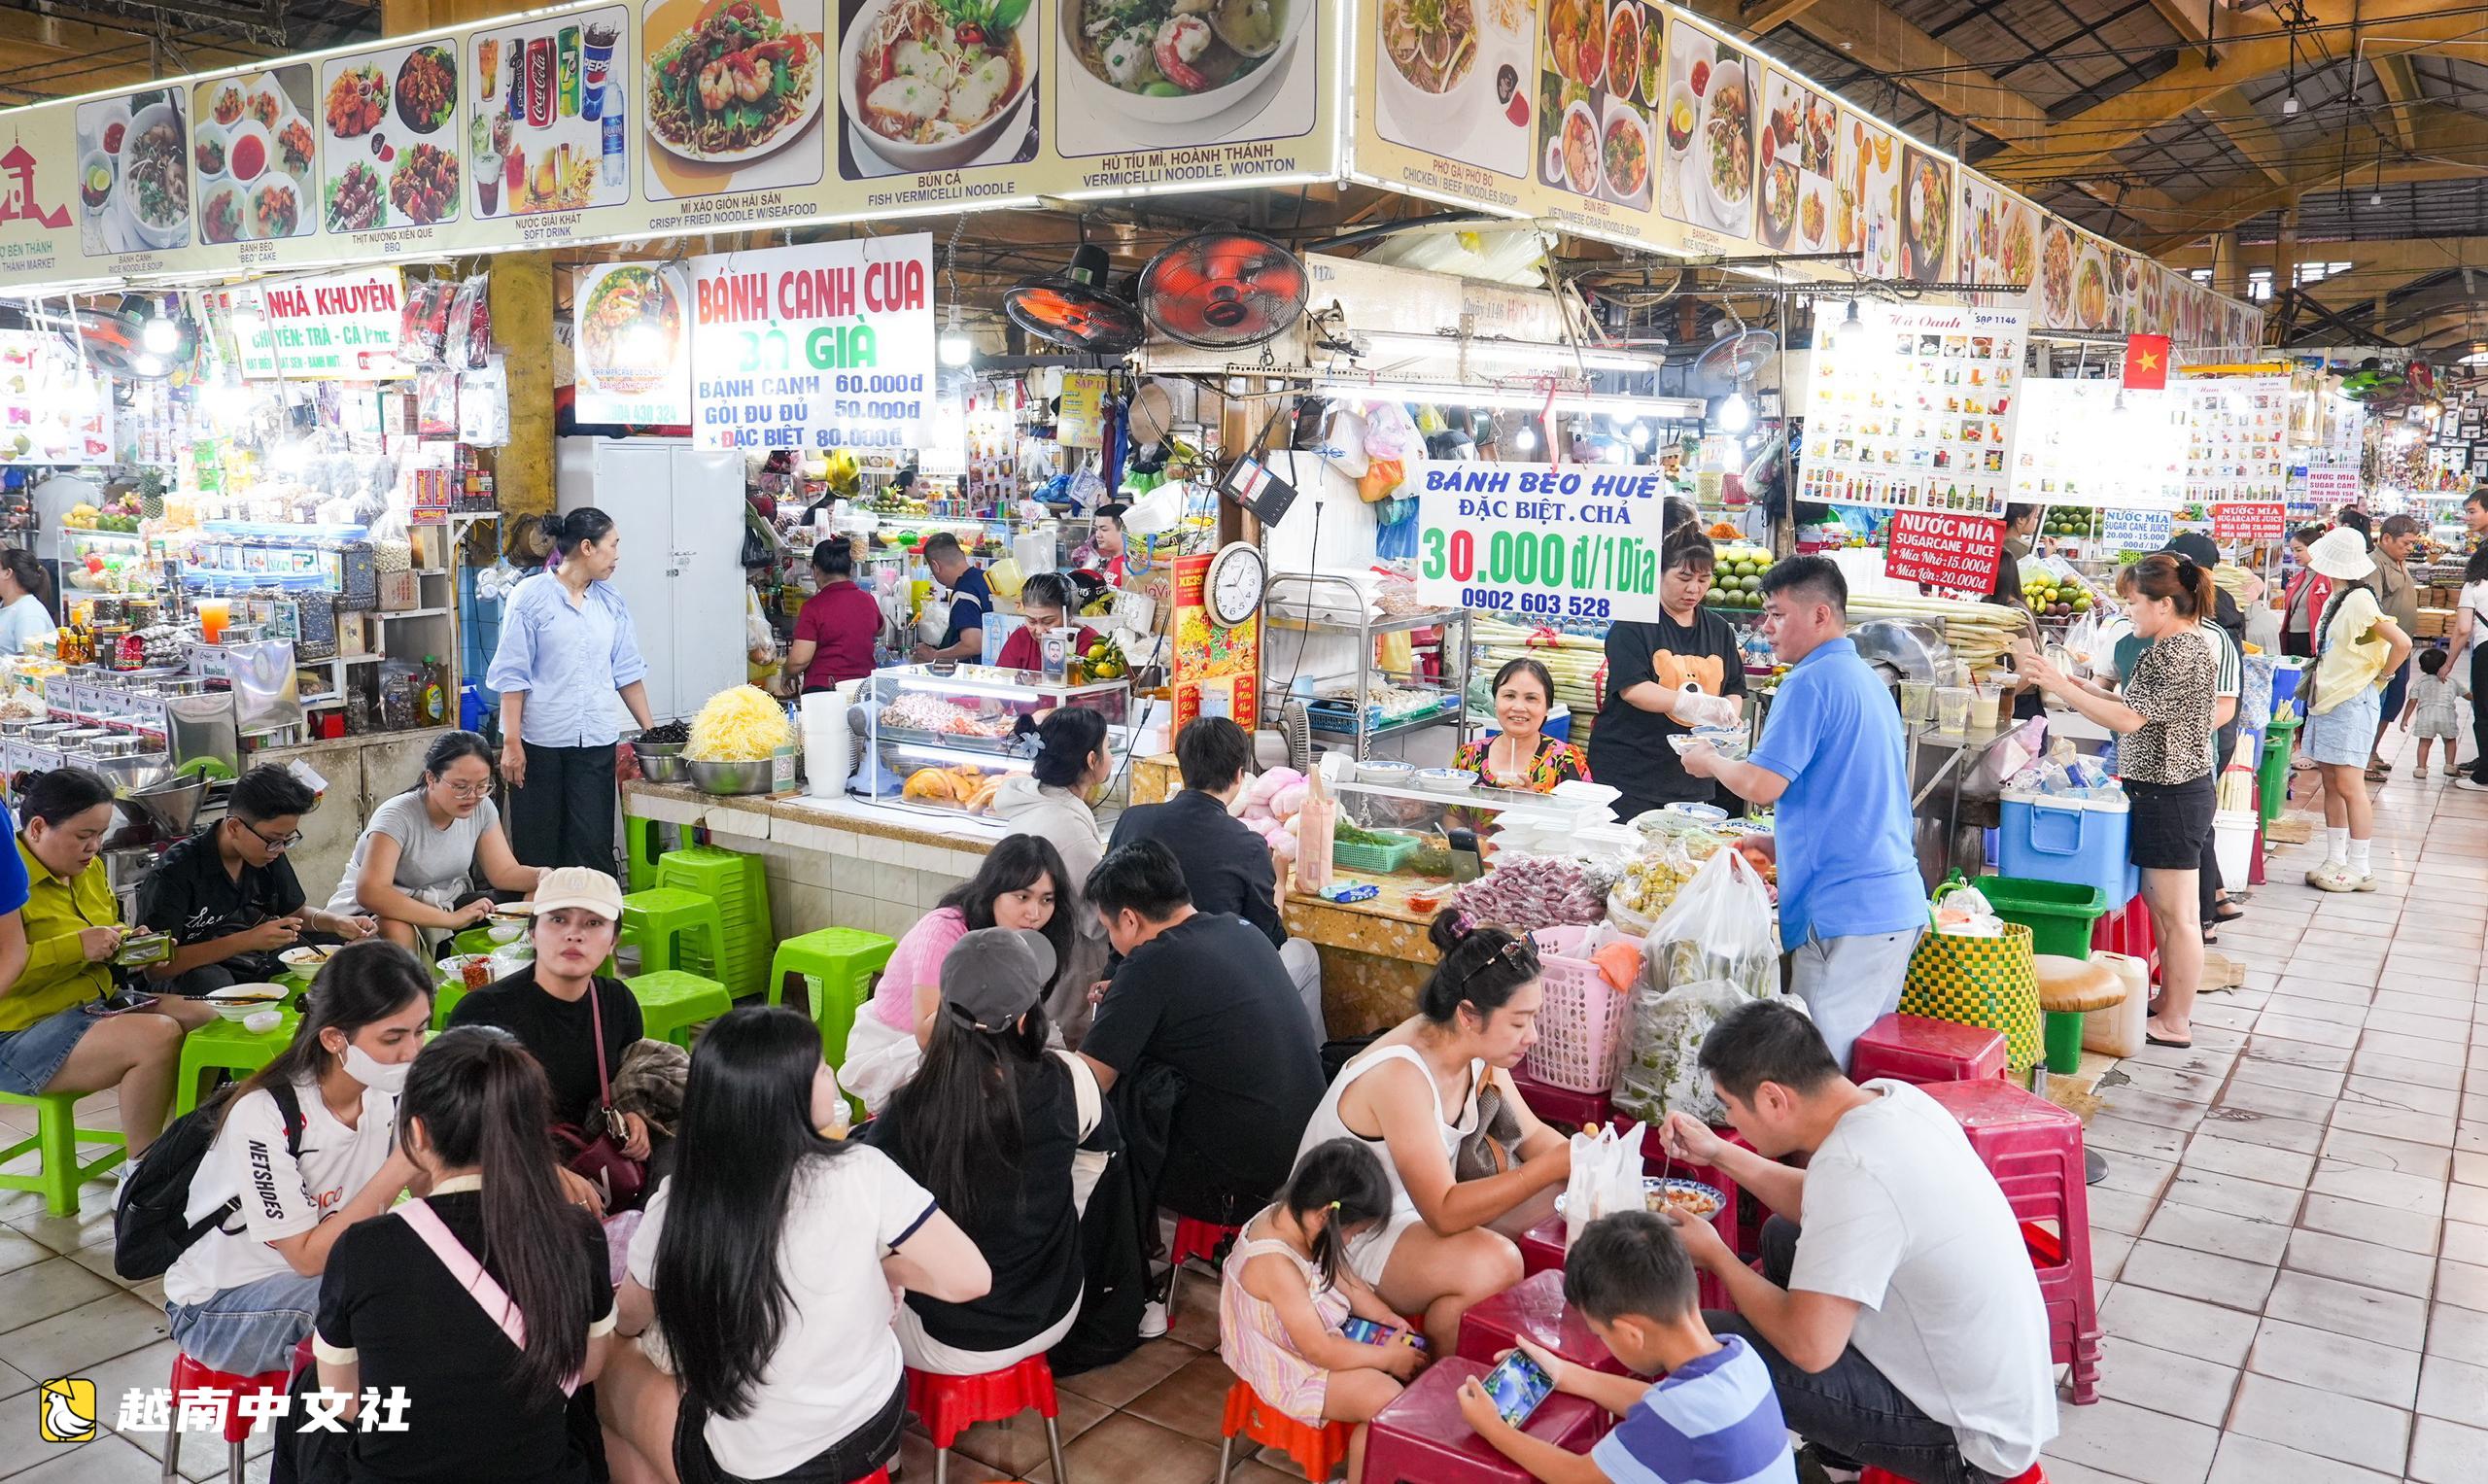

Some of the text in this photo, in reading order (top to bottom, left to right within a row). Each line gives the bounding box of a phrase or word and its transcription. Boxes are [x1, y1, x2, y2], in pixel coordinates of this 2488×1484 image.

[1102, 142, 1274, 171] HỦ TÍU MÌ, HOÀNH THÁNH
[917, 169, 962, 189] BÚN CÁ
[1084, 157, 1296, 188] VERMICELLI NOODLE, WONTON
[868, 182, 1015, 207] FISH VERMICELLI NOODLE
[1402, 166, 1518, 207] CHICKEN BEEF NOODLES SOUP
[649, 202, 817, 231] CRISPY FRIED NOODLE W/SEAFOOD
[1547, 205, 1641, 238] VIETNAMESE CRAB NOODLE SOUP
[416, 227, 433, 240] QUE
[524, 227, 571, 241] SOFT DRINK
[259, 251, 277, 262] CAKE
[384, 242, 400, 254] BBQ
[26, 257, 55, 270] MARKET
[108, 260, 163, 274] RICE NOODLE SOUP
[267, 277, 397, 319] NHÃ KHUYÊN
[698, 259, 924, 325] BÁNH CANH CUA
[1975, 315, 2017, 326] SẠP 1146
[805, 313, 878, 370] GIÀ
[699, 373, 923, 398] BÁNH CANH 60.000đ
[705, 396, 921, 424] GỎI ĐU ĐỦ 50.000đ
[721, 425, 758, 450] ĐẶC
[764, 423, 805, 450] BIỆT
[1427, 465, 1661, 499] BÁNH BÈO HUẾ
[1459, 496, 1632, 526] ĐẶC BIỆT CHẢ
[2106, 509, 2169, 524] NƯỚC MÍA
[2222, 504, 2279, 515] NƯỚC MÍA
[1899, 512, 1995, 543] NƯỚC MÍA
[2104, 521, 2169, 533] SUGAR CANE JUICE
[1895, 532, 1963, 554] SUGARCANE
[1965, 542, 1996, 558] JUICE
[1898, 547, 1919, 563] Mía
[1895, 563, 1917, 578] Mía
[1462, 587, 1610, 618] 0902 603 528
[248, 1139, 285, 1221] NETSHOES
